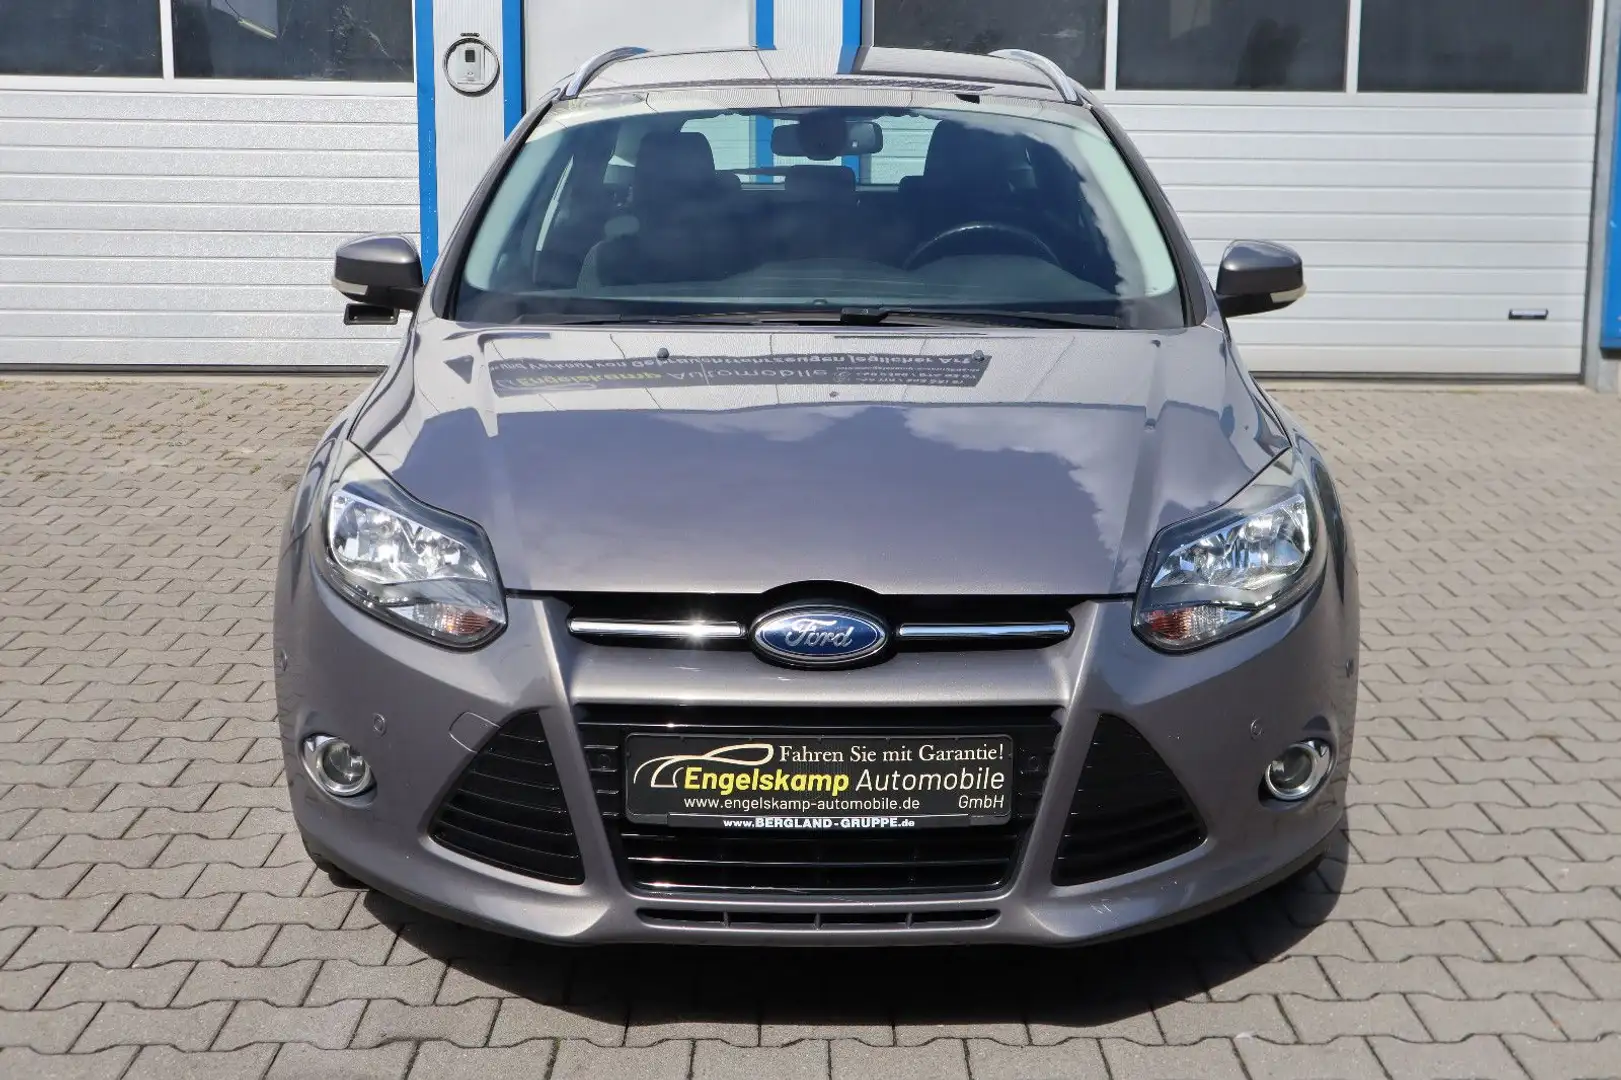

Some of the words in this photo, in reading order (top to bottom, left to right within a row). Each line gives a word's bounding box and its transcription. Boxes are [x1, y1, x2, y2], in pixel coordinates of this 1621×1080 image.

[785, 618, 854, 647] Ford
[779, 745, 844, 762] Fahren
[850, 745, 876, 762] Sie
[883, 745, 912, 762] mit
[918, 744, 1003, 761] Garantie!
[684, 767, 849, 796] Engelskamp
[855, 769, 1004, 791] Automobile
[684, 796, 920, 812] www.engelskamp-automobile.de
[958, 795, 1004, 809] GmbH
[723, 818, 915, 828] www.BERGLAND-GRUPPE.de
